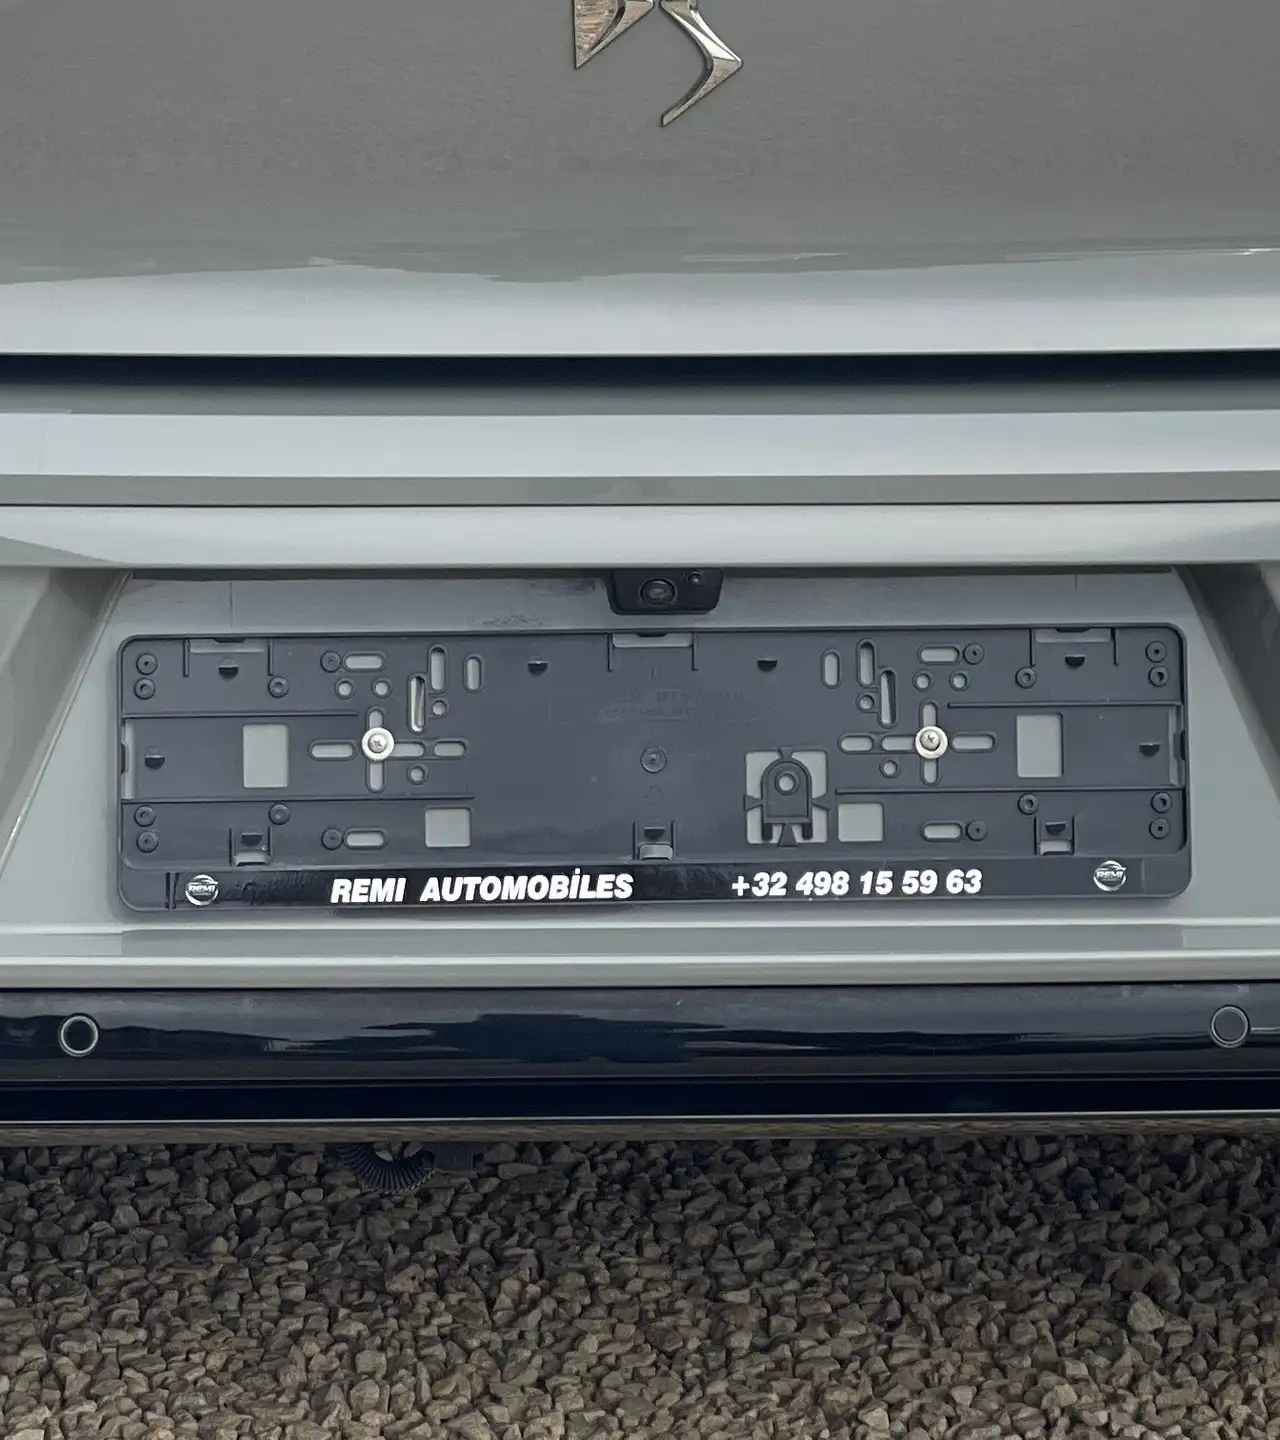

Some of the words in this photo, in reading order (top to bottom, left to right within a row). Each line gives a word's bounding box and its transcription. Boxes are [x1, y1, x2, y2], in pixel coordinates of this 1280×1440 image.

[330, 877, 407, 904] REMI
[731, 871, 789, 898] +32
[794, 870, 851, 897] 498
[859, 870, 894, 896] 15
[901, 869, 939, 895] 59
[945, 868, 983, 895] 63
